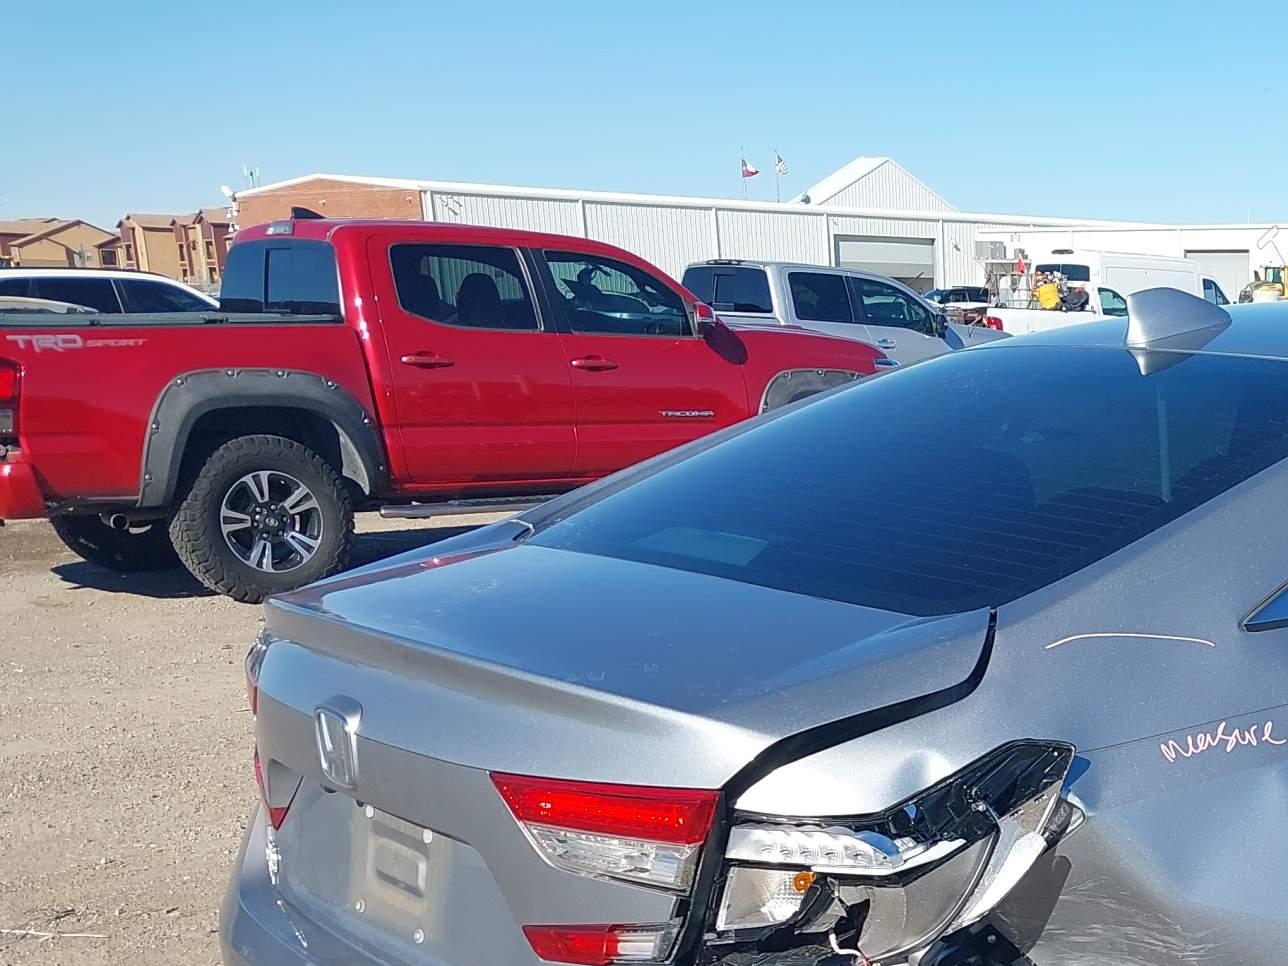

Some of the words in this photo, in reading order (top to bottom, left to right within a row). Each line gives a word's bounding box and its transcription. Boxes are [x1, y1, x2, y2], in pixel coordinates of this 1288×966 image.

[6, 334, 82, 352] TRD
[86, 338, 147, 347] SPORT
[658, 410, 715, 418] TACOMA
